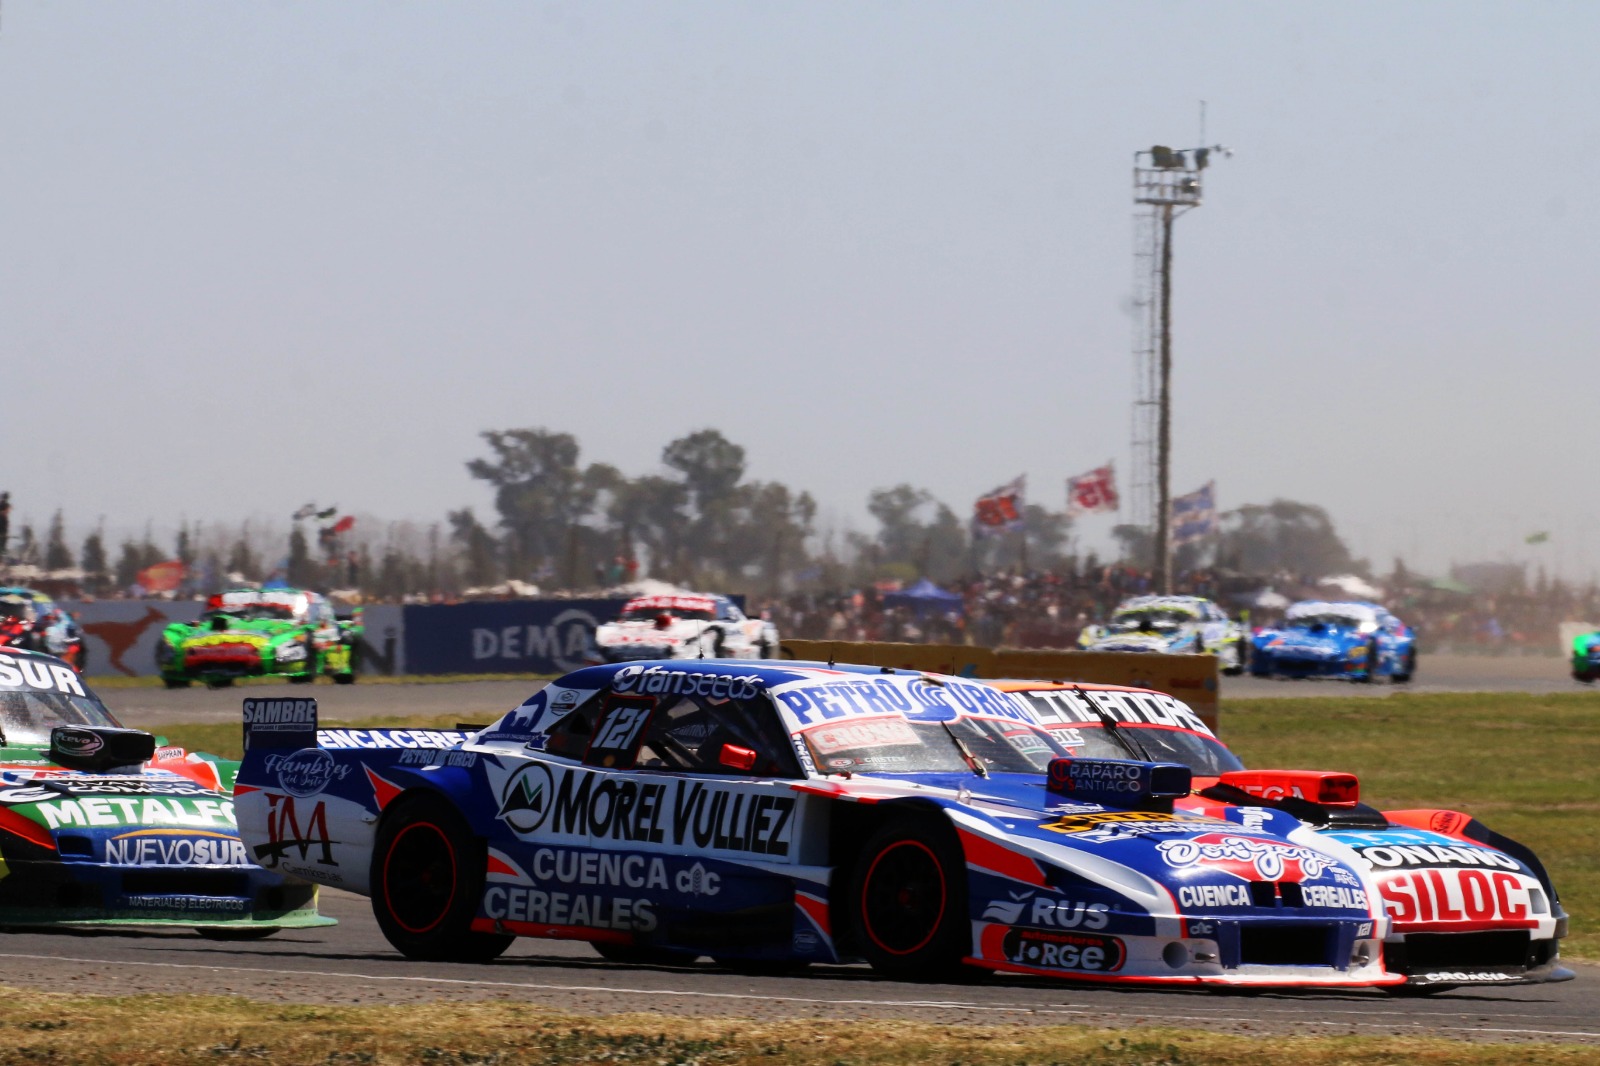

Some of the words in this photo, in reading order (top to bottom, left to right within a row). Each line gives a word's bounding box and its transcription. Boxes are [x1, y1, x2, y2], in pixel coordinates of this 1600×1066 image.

[0, 654, 86, 697] SUR
[243, 701, 317, 723] SAMBRE
[776, 678, 912, 725] PETRO
[591, 707, 650, 749] 121
[399, 751, 436, 764] PETRO
[1070, 765, 1141, 780] RAPARO
[674, 780, 795, 856] VULLIEZ
[106, 837, 248, 865] NUEVOSUR
[533, 848, 669, 890] CUENCA
[129, 897, 187, 910] MATERIALES
[484, 887, 658, 931] CEREALES
[1178, 885, 1251, 908] CUENCA
[1302, 886, 1369, 911] CEREALES
[1377, 869, 1527, 921] SILOC
[1031, 899, 1110, 930] RUS
